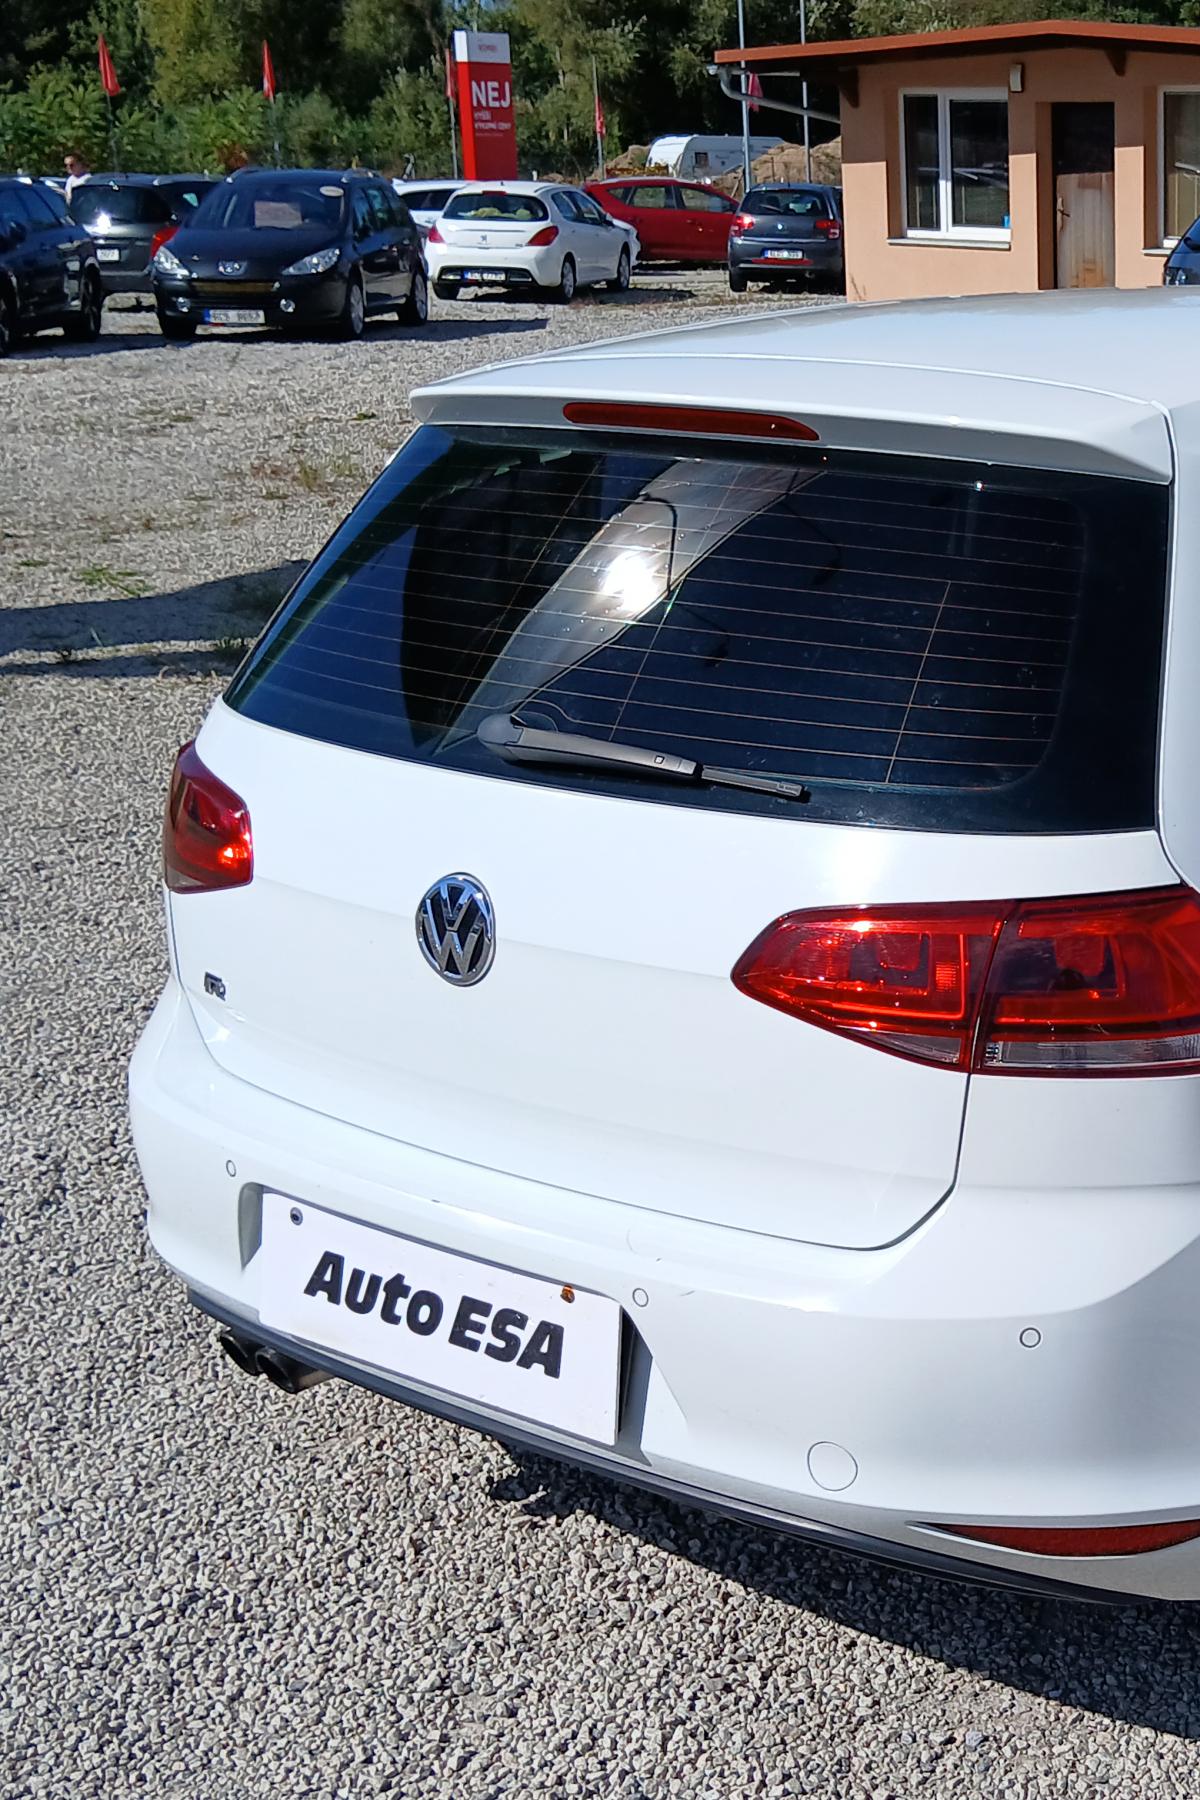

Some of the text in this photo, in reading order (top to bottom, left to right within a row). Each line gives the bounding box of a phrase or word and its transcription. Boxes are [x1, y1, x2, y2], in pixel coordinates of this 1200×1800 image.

[471, 80, 511, 108] NEJ
[303, 1250, 565, 1379] Auto ESA
